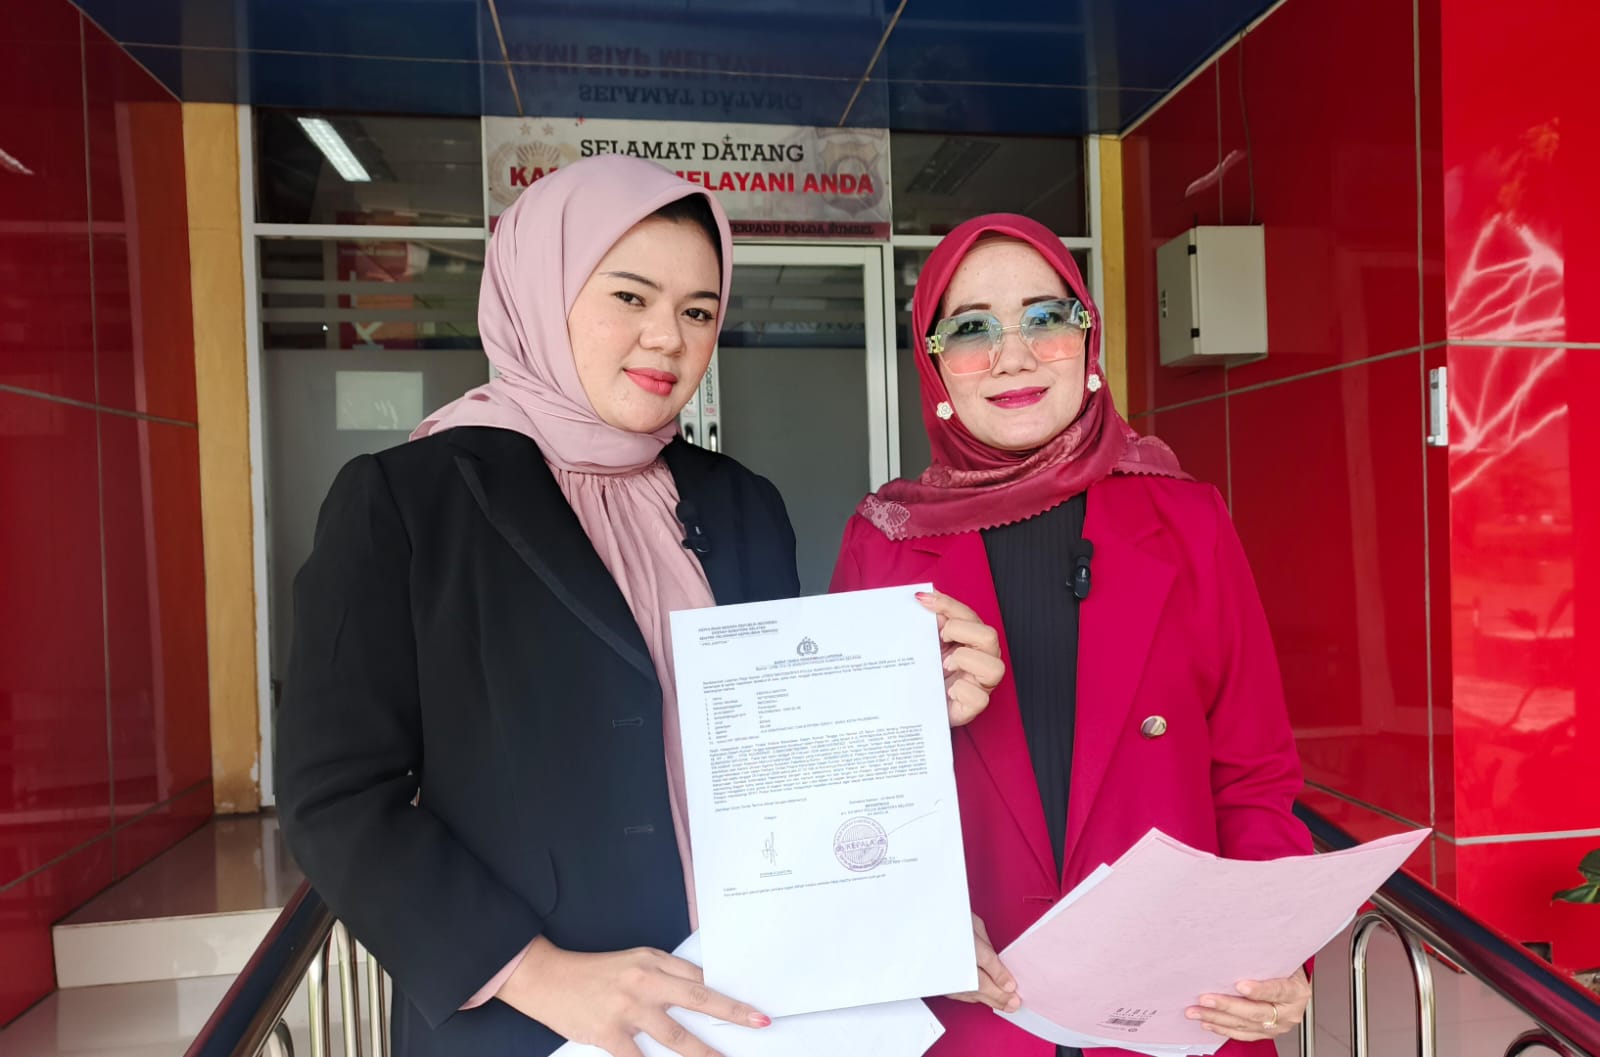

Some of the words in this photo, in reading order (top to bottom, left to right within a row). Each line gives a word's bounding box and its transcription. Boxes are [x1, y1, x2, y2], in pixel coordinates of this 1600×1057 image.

[580, 139, 696, 160] SELAMAT
[702, 142, 804, 162] DATANG
[803, 173, 874, 194] ANDA
[784, 223, 825, 235] POLDA
[828, 222, 875, 236] SUMSEL
